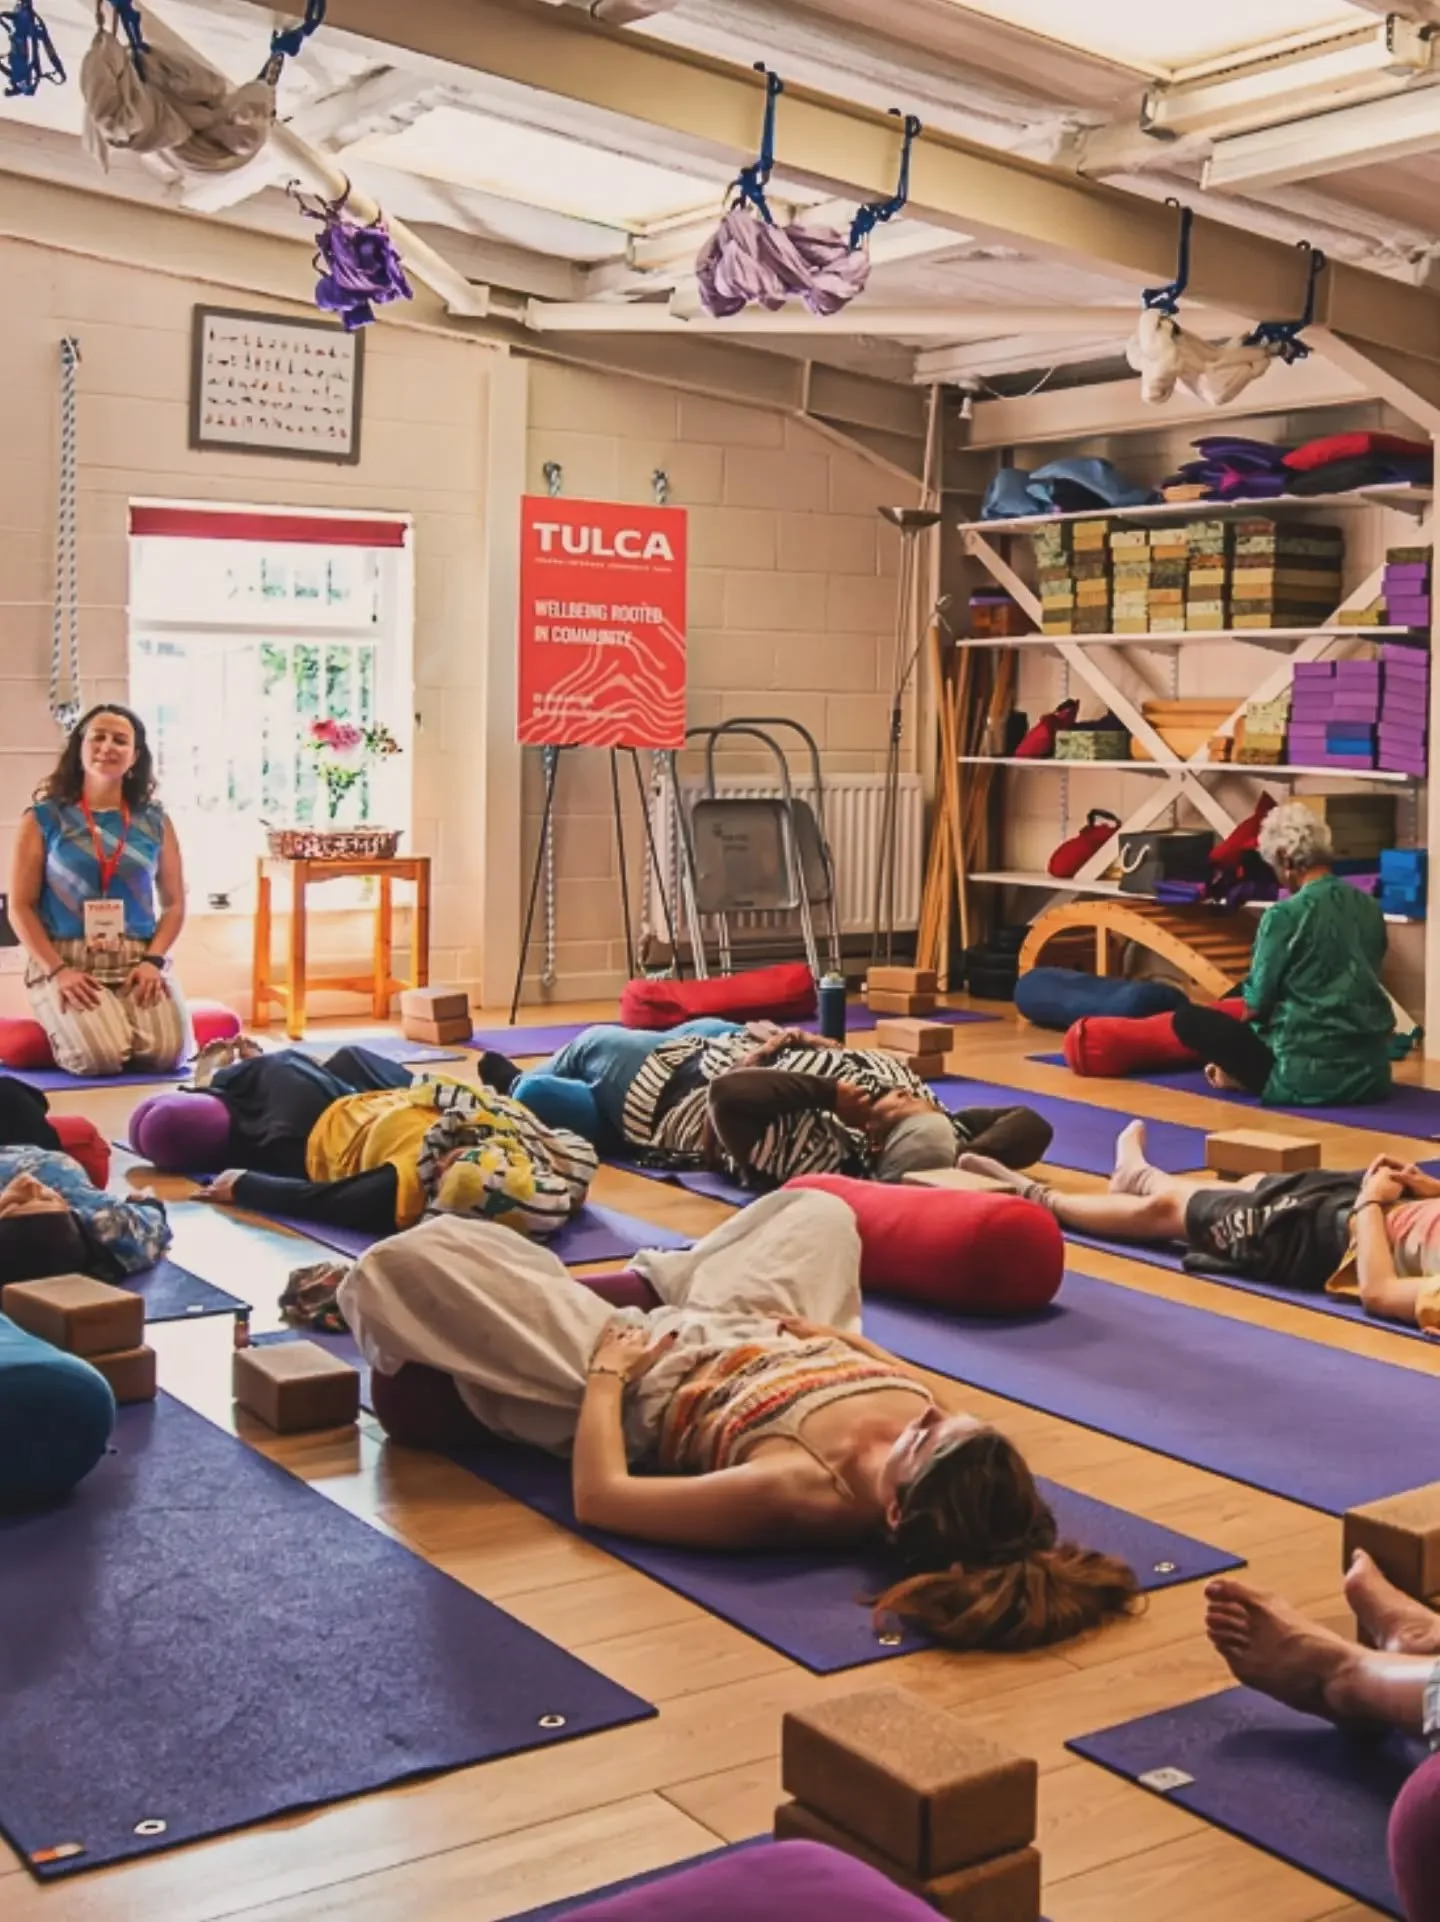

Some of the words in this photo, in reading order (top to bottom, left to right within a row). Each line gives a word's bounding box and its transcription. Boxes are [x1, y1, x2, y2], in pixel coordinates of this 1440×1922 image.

[532, 521, 675, 561] TULCA
[534, 599, 608, 621] WELLBEING
[611, 604, 663, 624] ROOTED
[534, 625, 549, 642] IN
[551, 626, 632, 647] COMMUNITY
